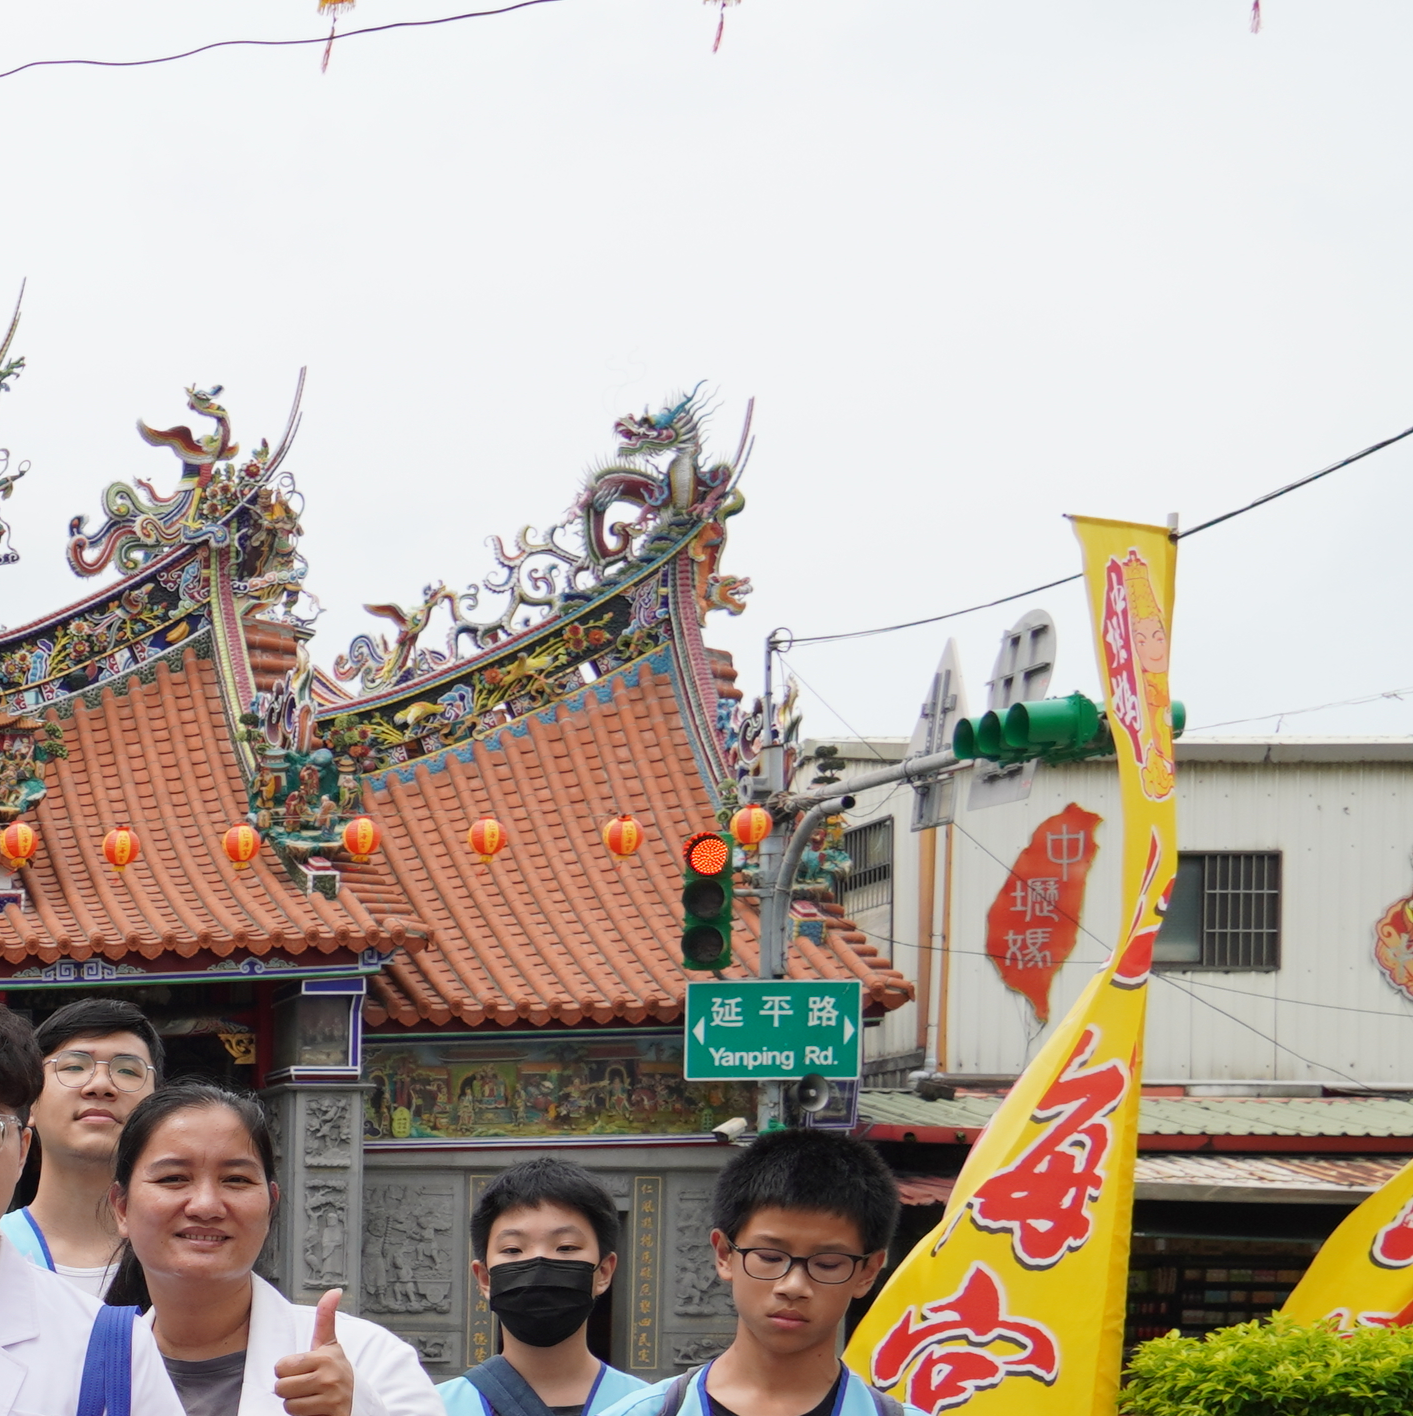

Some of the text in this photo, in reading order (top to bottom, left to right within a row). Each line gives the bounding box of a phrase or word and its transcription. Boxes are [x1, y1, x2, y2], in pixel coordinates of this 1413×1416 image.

[1003, 824, 1085, 970] 中壢媽
[711, 995, 839, 1029] 延平路
[709, 1046, 838, 1070] Yanping Rd.
